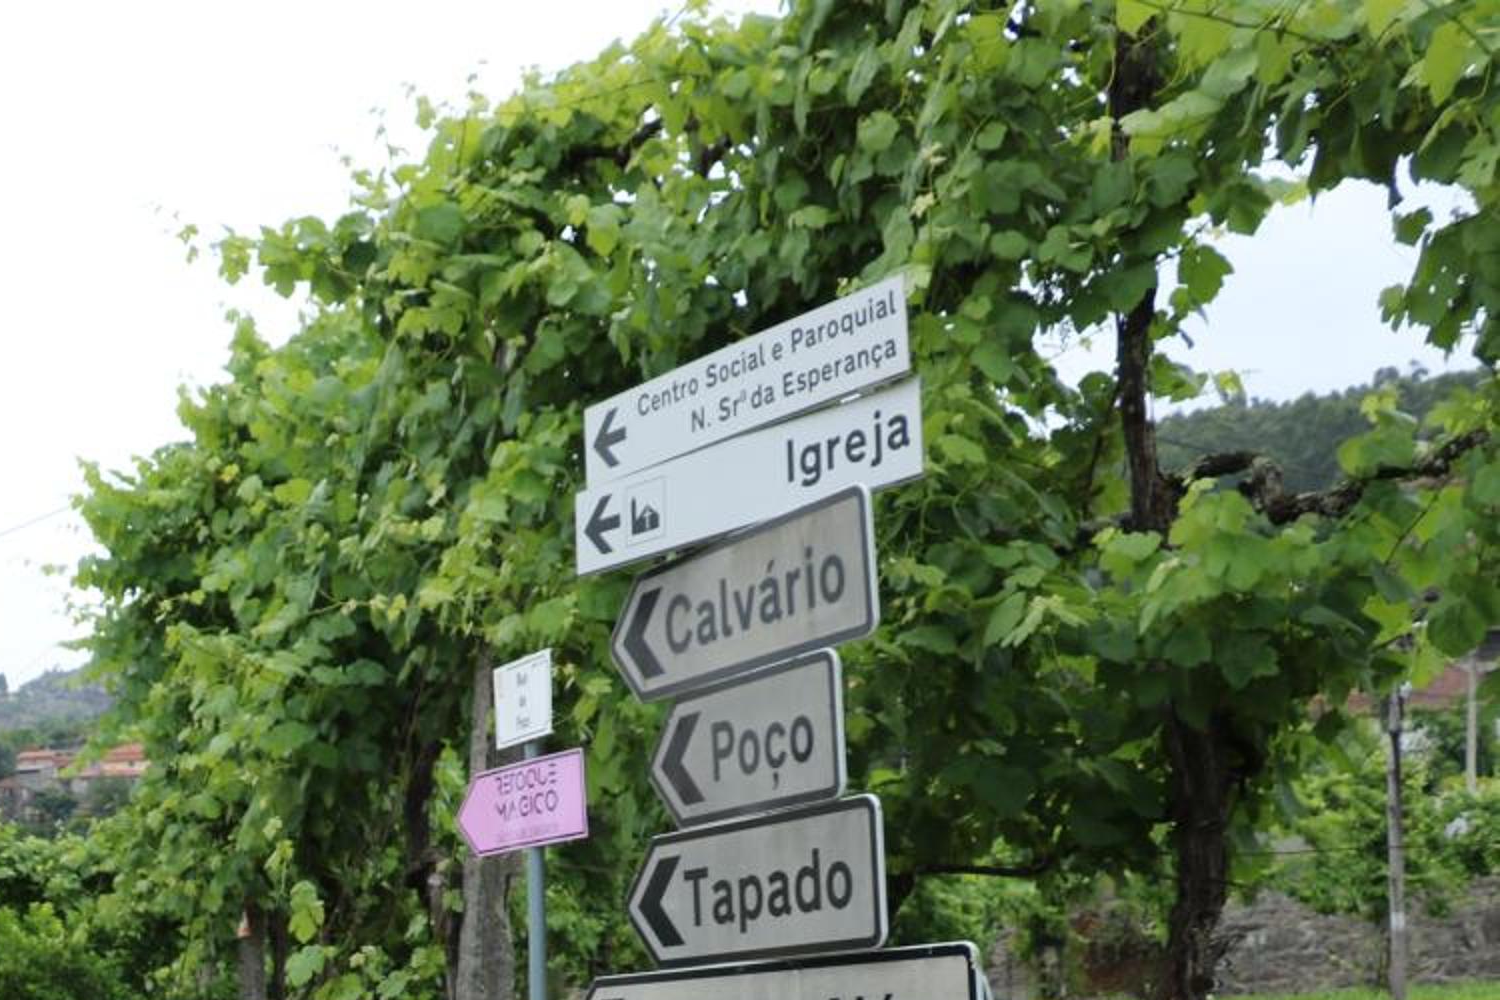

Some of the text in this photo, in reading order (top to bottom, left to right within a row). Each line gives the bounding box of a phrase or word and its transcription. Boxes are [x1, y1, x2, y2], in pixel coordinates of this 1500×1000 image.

[636, 289, 898, 418] Centro Social e Paroquial
[691, 405, 711, 433] N.
[751, 384, 775, 410] da
[782, 336, 898, 398] Esperança
[786, 408, 912, 488] Igreja
[664, 546, 846, 655] Calvário
[711, 714, 815, 791] Poço
[684, 848, 853, 934] Tapado
